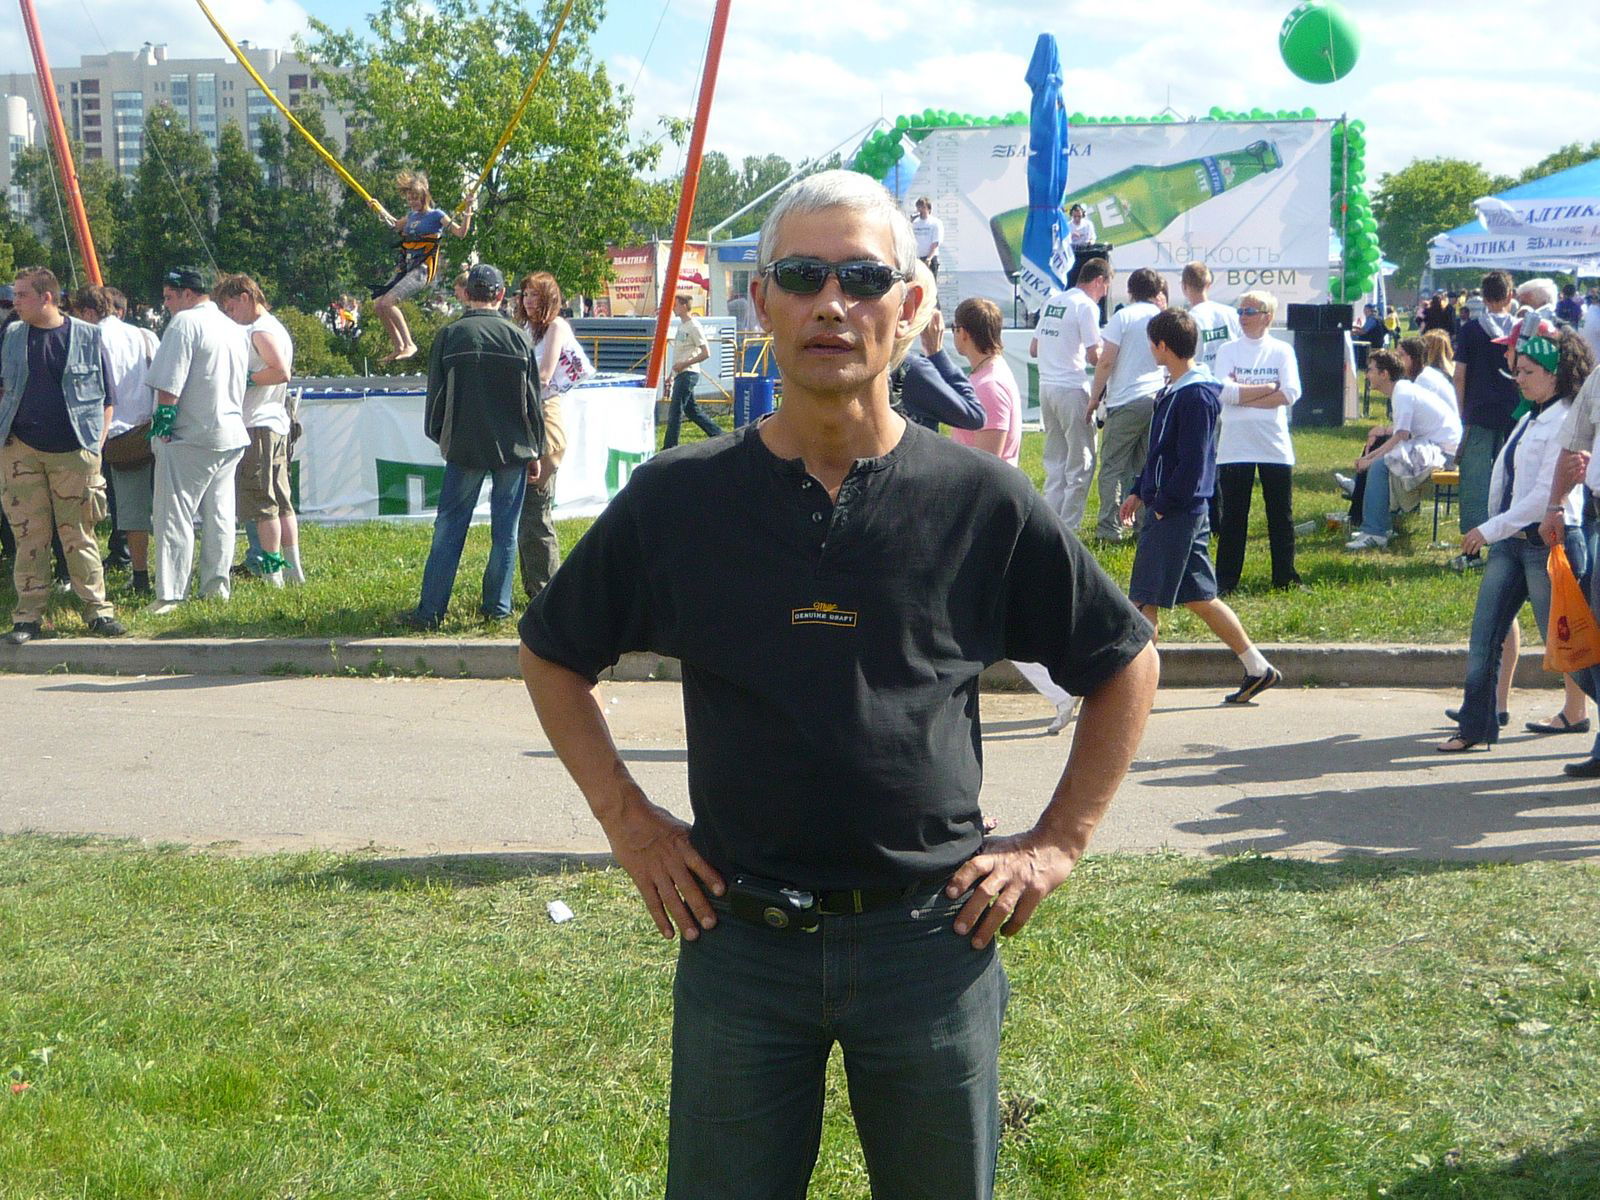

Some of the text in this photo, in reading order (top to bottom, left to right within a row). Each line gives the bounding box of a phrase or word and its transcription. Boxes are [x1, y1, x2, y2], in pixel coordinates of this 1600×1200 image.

[1006, 143, 1092, 158] БАКА
[1153, 241, 1281, 264] Легкость
[1227, 269, 1296, 286] всем
